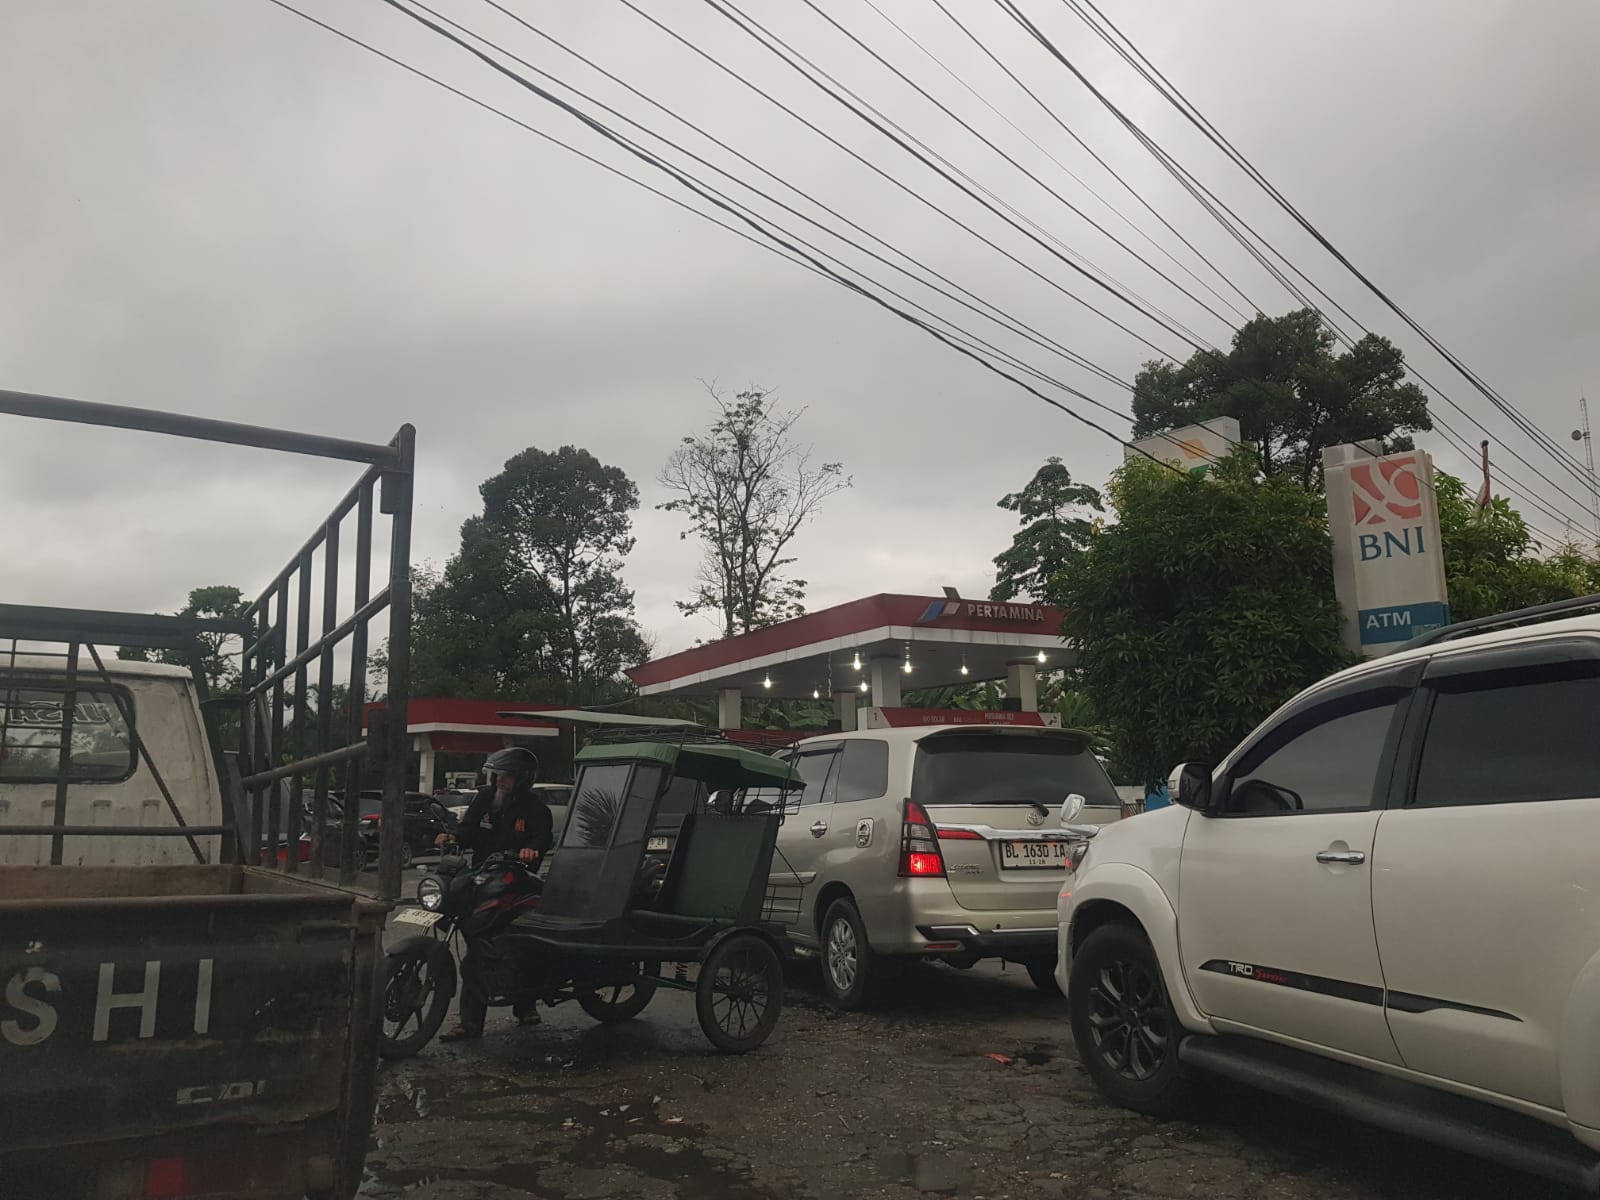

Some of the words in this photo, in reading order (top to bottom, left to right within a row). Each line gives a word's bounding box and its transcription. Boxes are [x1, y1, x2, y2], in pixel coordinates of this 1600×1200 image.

[1359, 526, 1425, 561] BNI
[967, 603, 1045, 622] PERTAMINA
[1366, 610, 1412, 629] ATM
[1005, 844, 1019, 858] BL
[1023, 844, 1049, 858] 1630
[1228, 961, 1253, 976] TRD
[0, 958, 214, 1047] SHI
